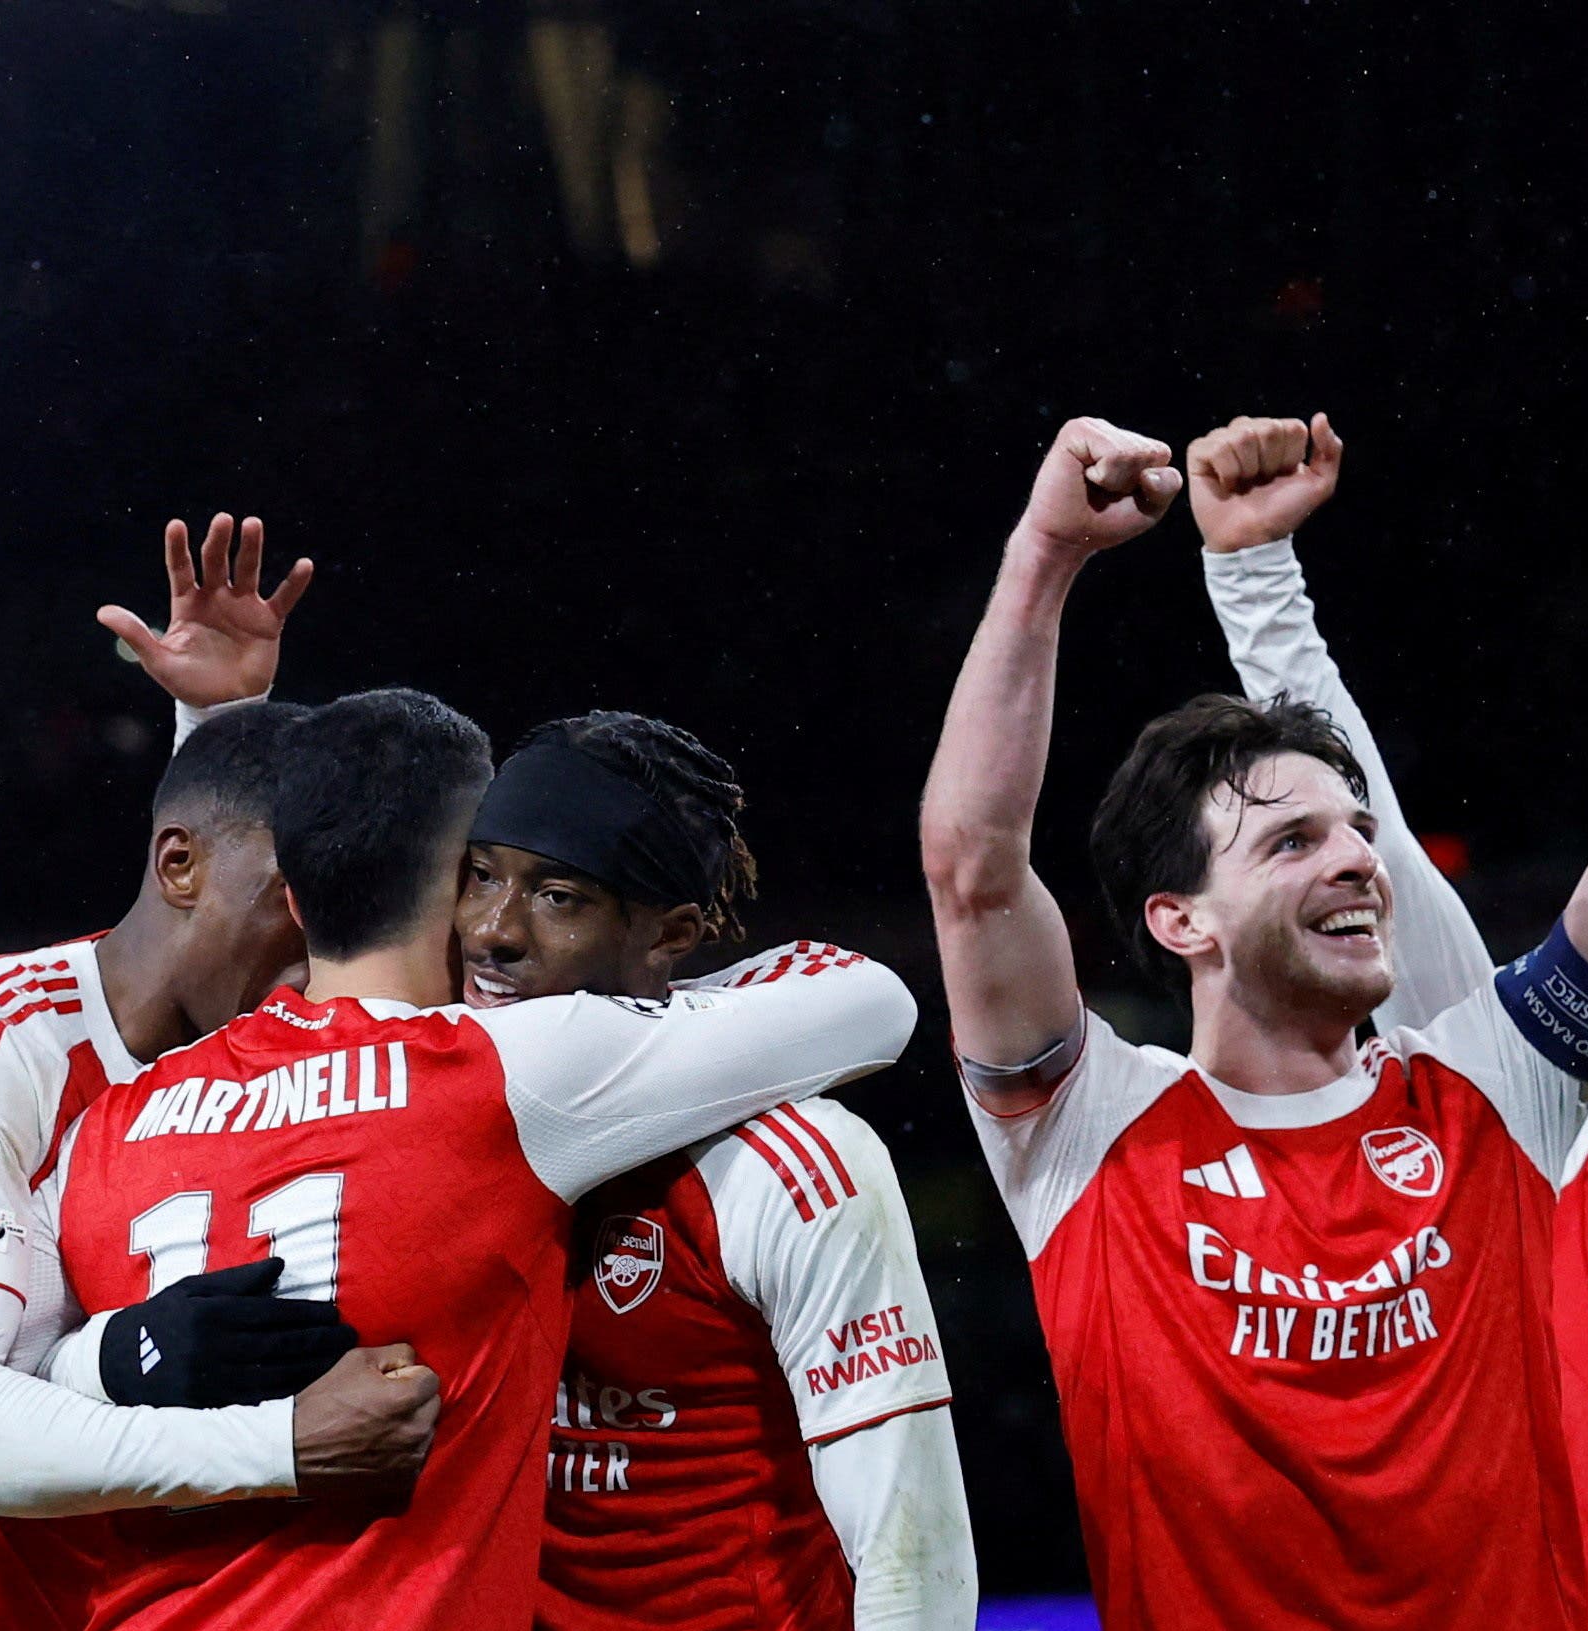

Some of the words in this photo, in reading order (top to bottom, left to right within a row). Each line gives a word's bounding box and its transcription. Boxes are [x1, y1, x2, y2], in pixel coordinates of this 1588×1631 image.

[263, 1001, 335, 1031] Arsenal
[1523, 985, 1576, 1045] RACISM
[123, 1041, 407, 1142] MARTINELLI
[128, 1172, 344, 1304] 11
[826, 1305, 905, 1353] VISIT
[1230, 1304, 1297, 1359] FLY
[1311, 1287, 1438, 1360] BETTER
[806, 1333, 938, 1396] RWANDA
